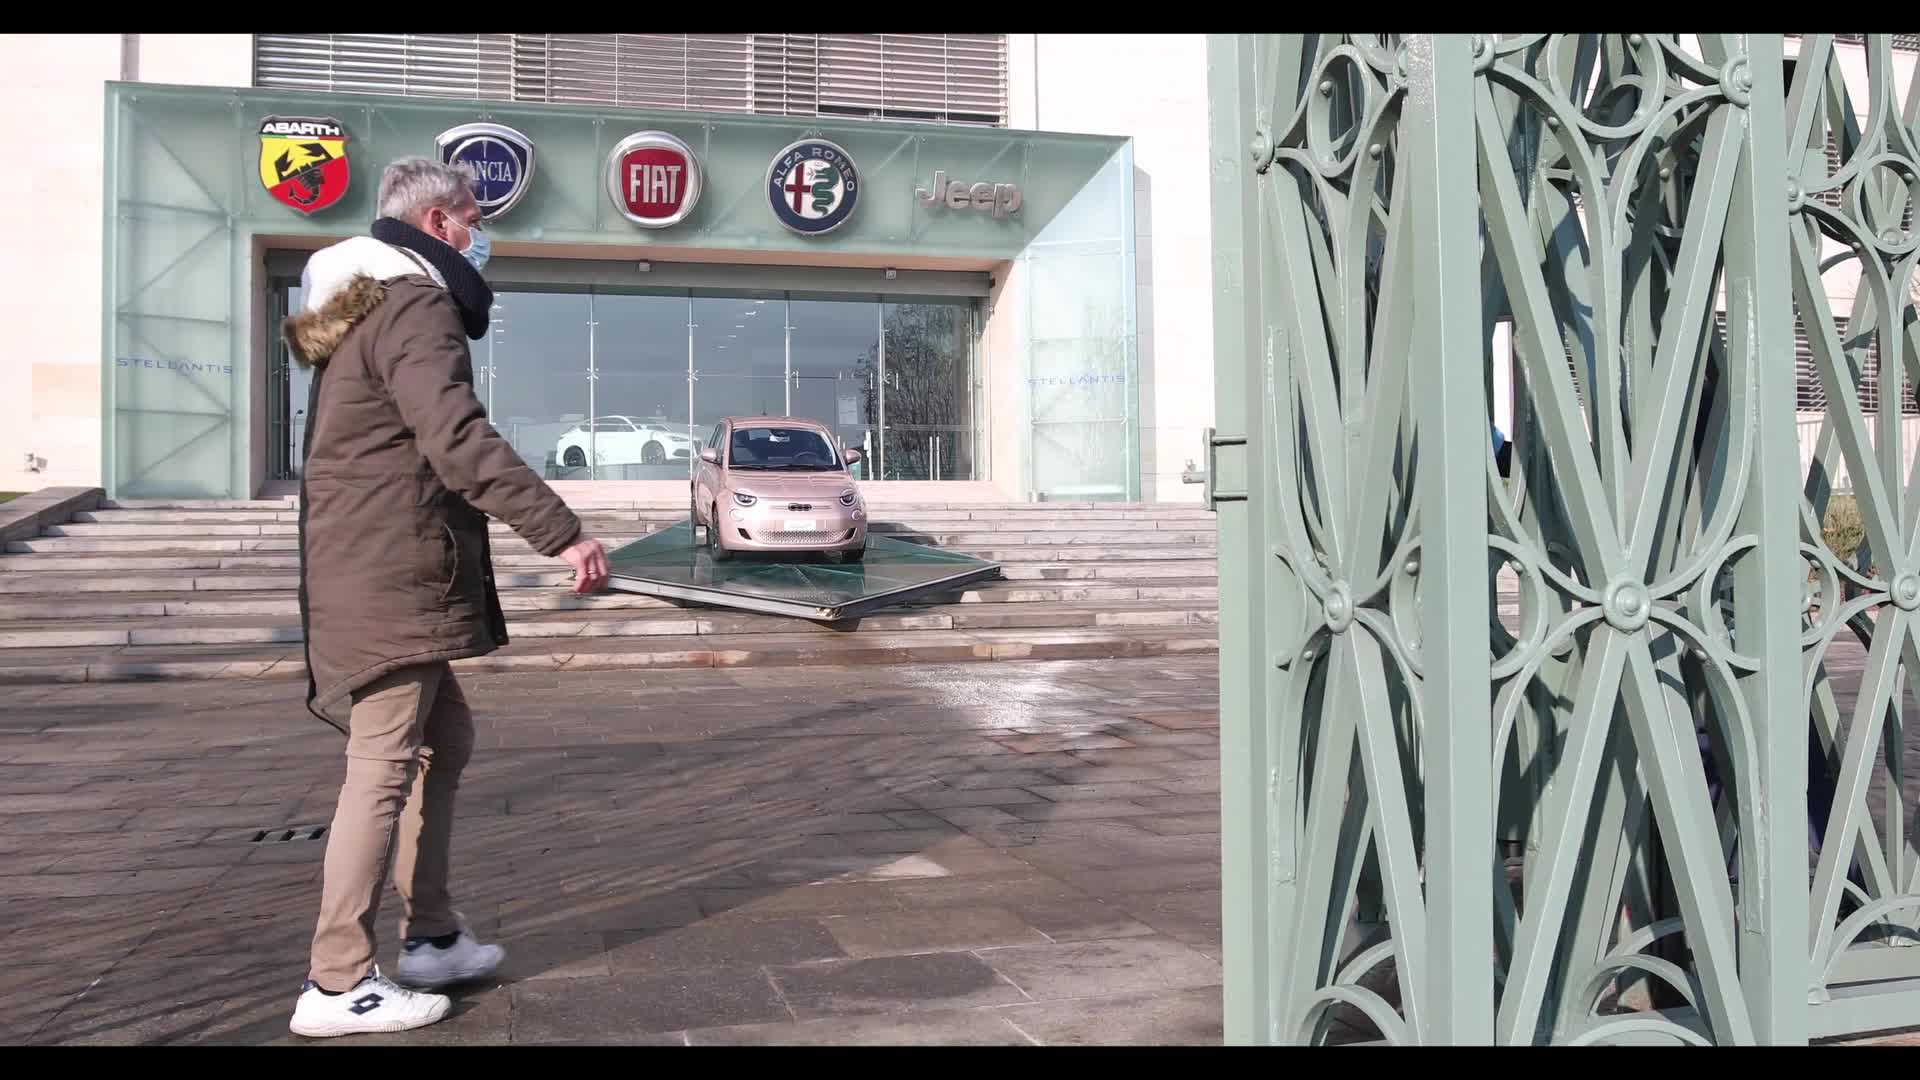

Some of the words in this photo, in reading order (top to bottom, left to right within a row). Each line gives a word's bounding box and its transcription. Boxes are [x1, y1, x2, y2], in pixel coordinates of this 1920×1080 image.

[262, 122, 340, 136] ABARTH
[469, 160, 514, 182] NCIA
[773, 151, 804, 187] ALFA
[811, 147, 855, 191] ROMEO
[630, 163, 681, 204] FIAT
[915, 170, 1022, 217] Jeep
[116, 359, 232, 374] STELLANTIS
[1027, 376, 1125, 385] STELLANTIS
